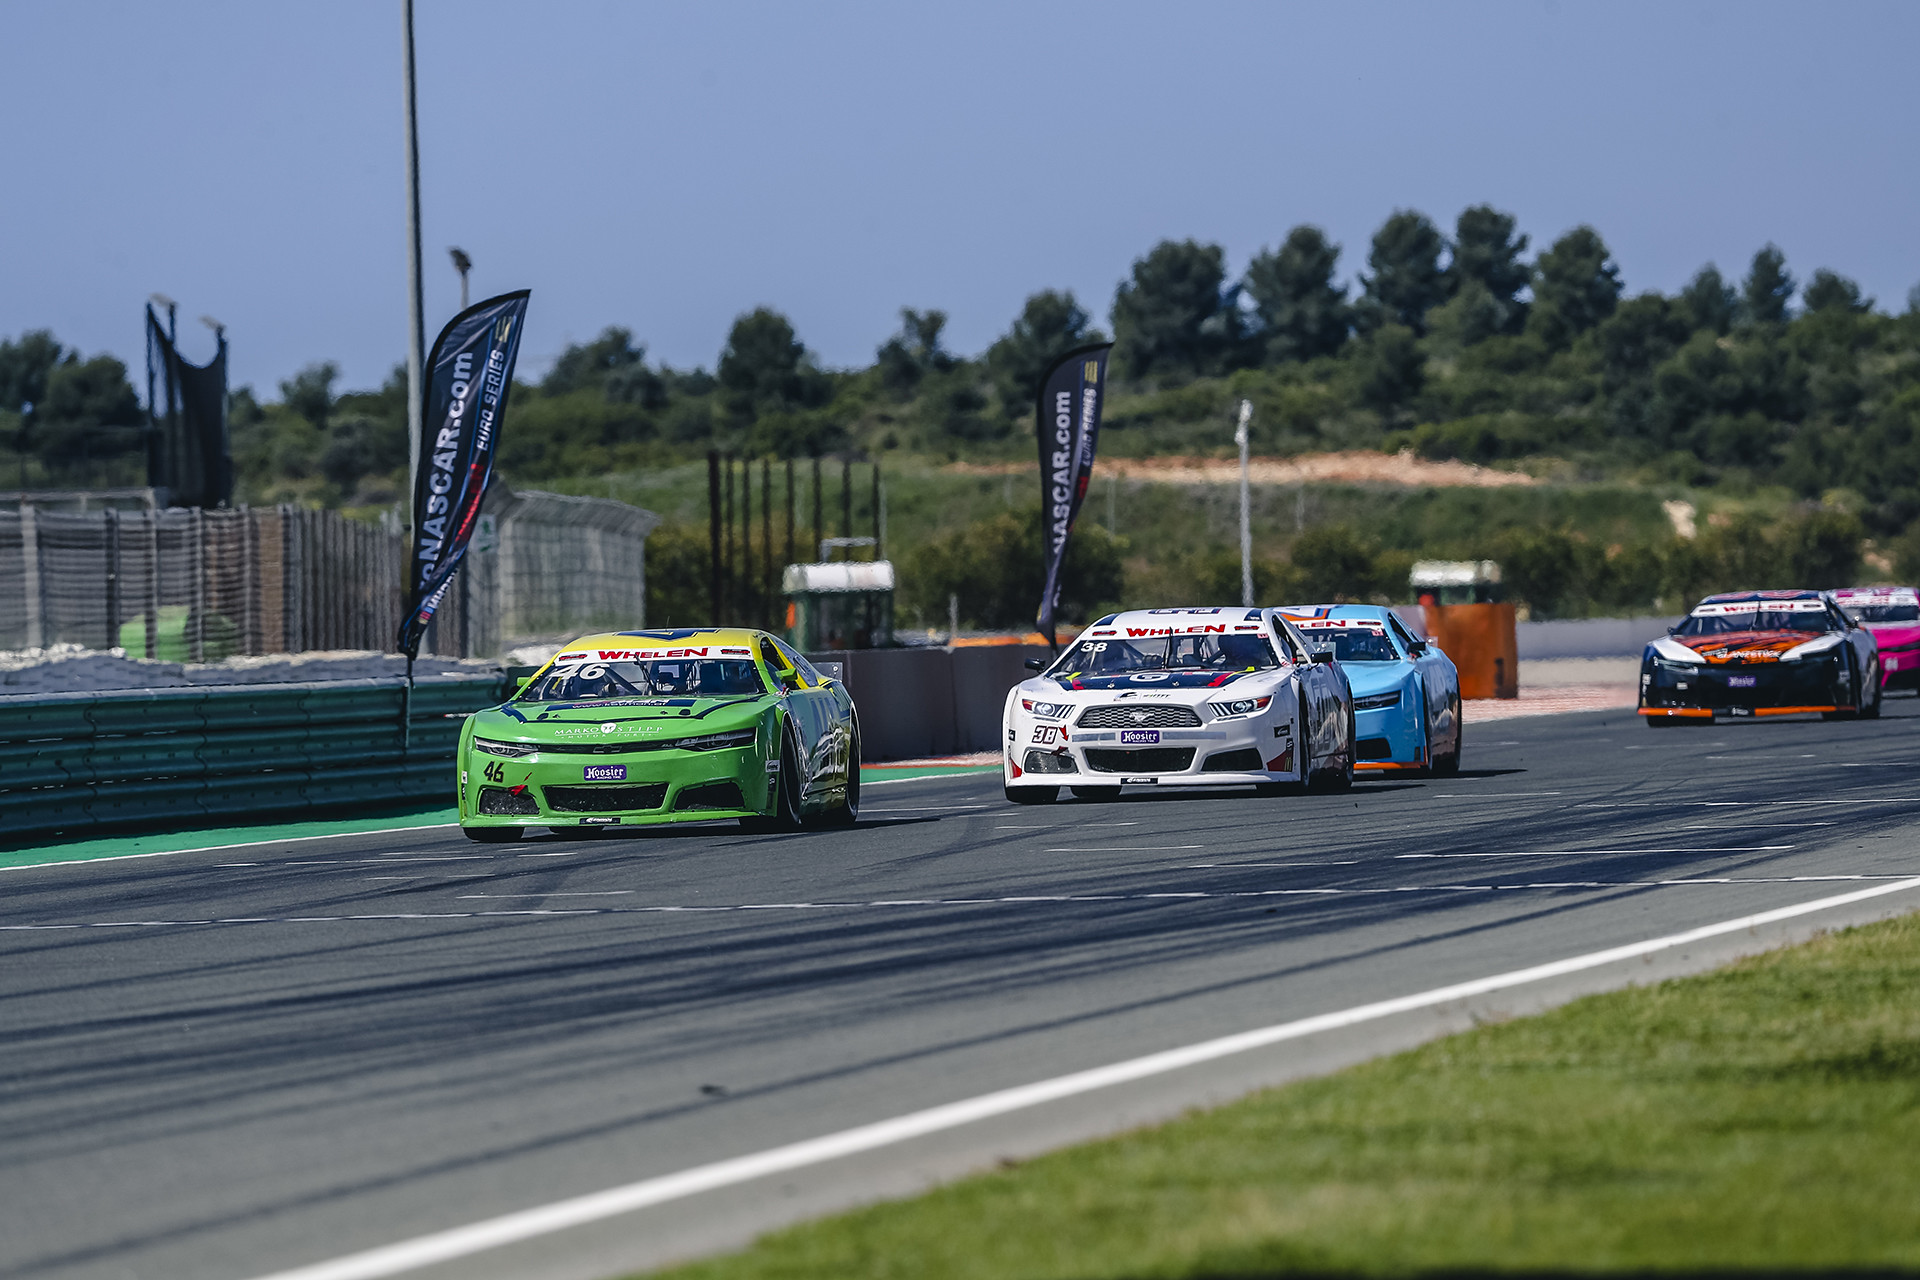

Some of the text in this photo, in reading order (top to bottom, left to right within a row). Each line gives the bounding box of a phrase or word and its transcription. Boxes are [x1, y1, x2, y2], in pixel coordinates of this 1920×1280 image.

[476, 349, 504, 451] EURO SERIES
[418, 352, 473, 590] ONASCAR.com
[598, 647, 709, 660] WHELEN
[1080, 642, 1108, 652] 38
[549, 663, 610, 680] 46
[554, 727, 600, 735] MARKO
[1031, 725, 1059, 745] 38
[1122, 730, 1158, 742] Hoosier
[483, 760, 505, 783] 46
[585, 765, 625, 779] Hoosier
